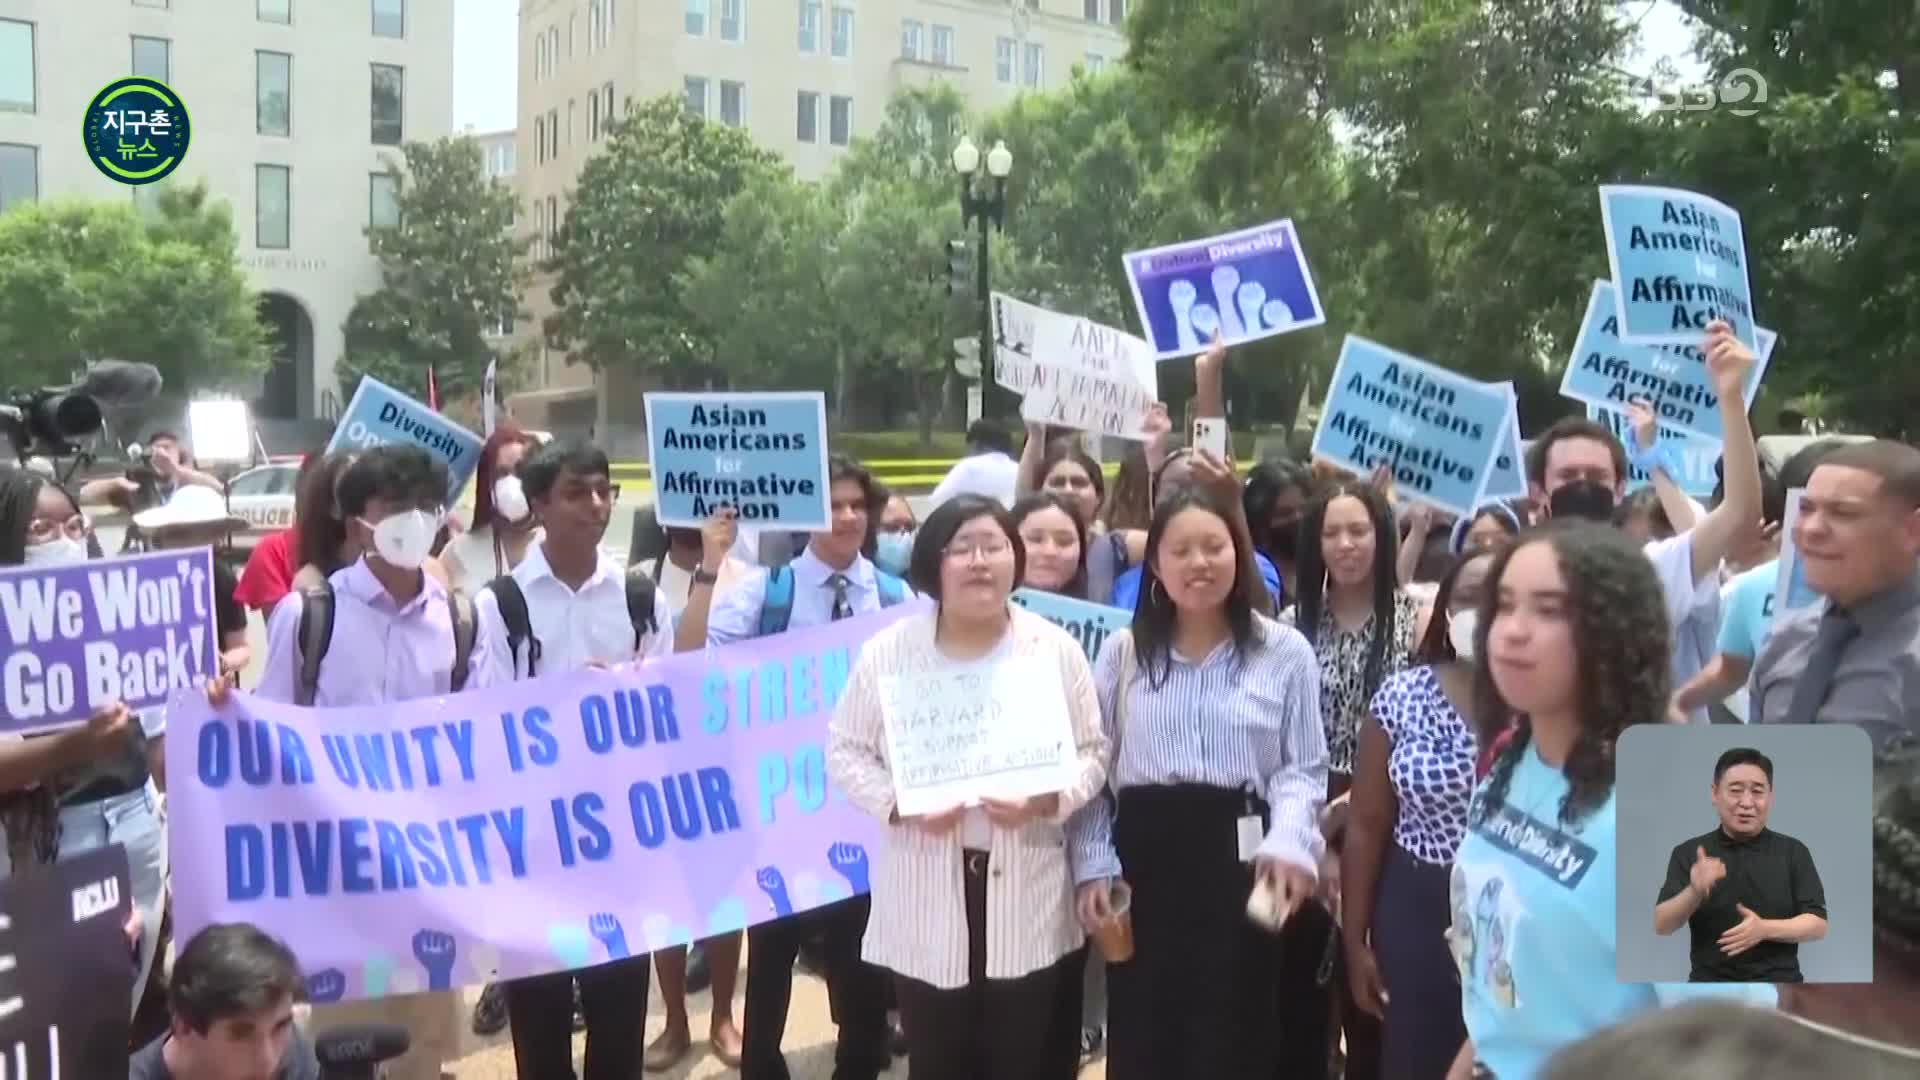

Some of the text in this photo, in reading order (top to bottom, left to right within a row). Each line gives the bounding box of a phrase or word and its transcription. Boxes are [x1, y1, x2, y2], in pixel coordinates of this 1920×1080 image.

[1662, 200, 1720, 233] Asian
[1630, 224, 1740, 268] Americans
[1631, 276, 1749, 318] Affirmative
[1381, 361, 1457, 405] Asian
[1582, 351, 1718, 408] Affirmativ
[690, 403, 767, 427] Asian
[1346, 371, 1484, 441] Americans
[379, 402, 464, 464] Diversity
[663, 427, 807, 450] Americans
[1329, 408, 1474, 482] Affirmative
[663, 471, 815, 496] Affirmative
[715, 456, 744, 474] for
[693, 494, 780, 520] Acion
[0, 559, 207, 645] We Won't
[4, 625, 210, 720] Go Back!
[197, 644, 850, 791] OUR UNITY IS OUR STREN
[224, 742, 844, 902] DIVERSITY IS OUR PO
